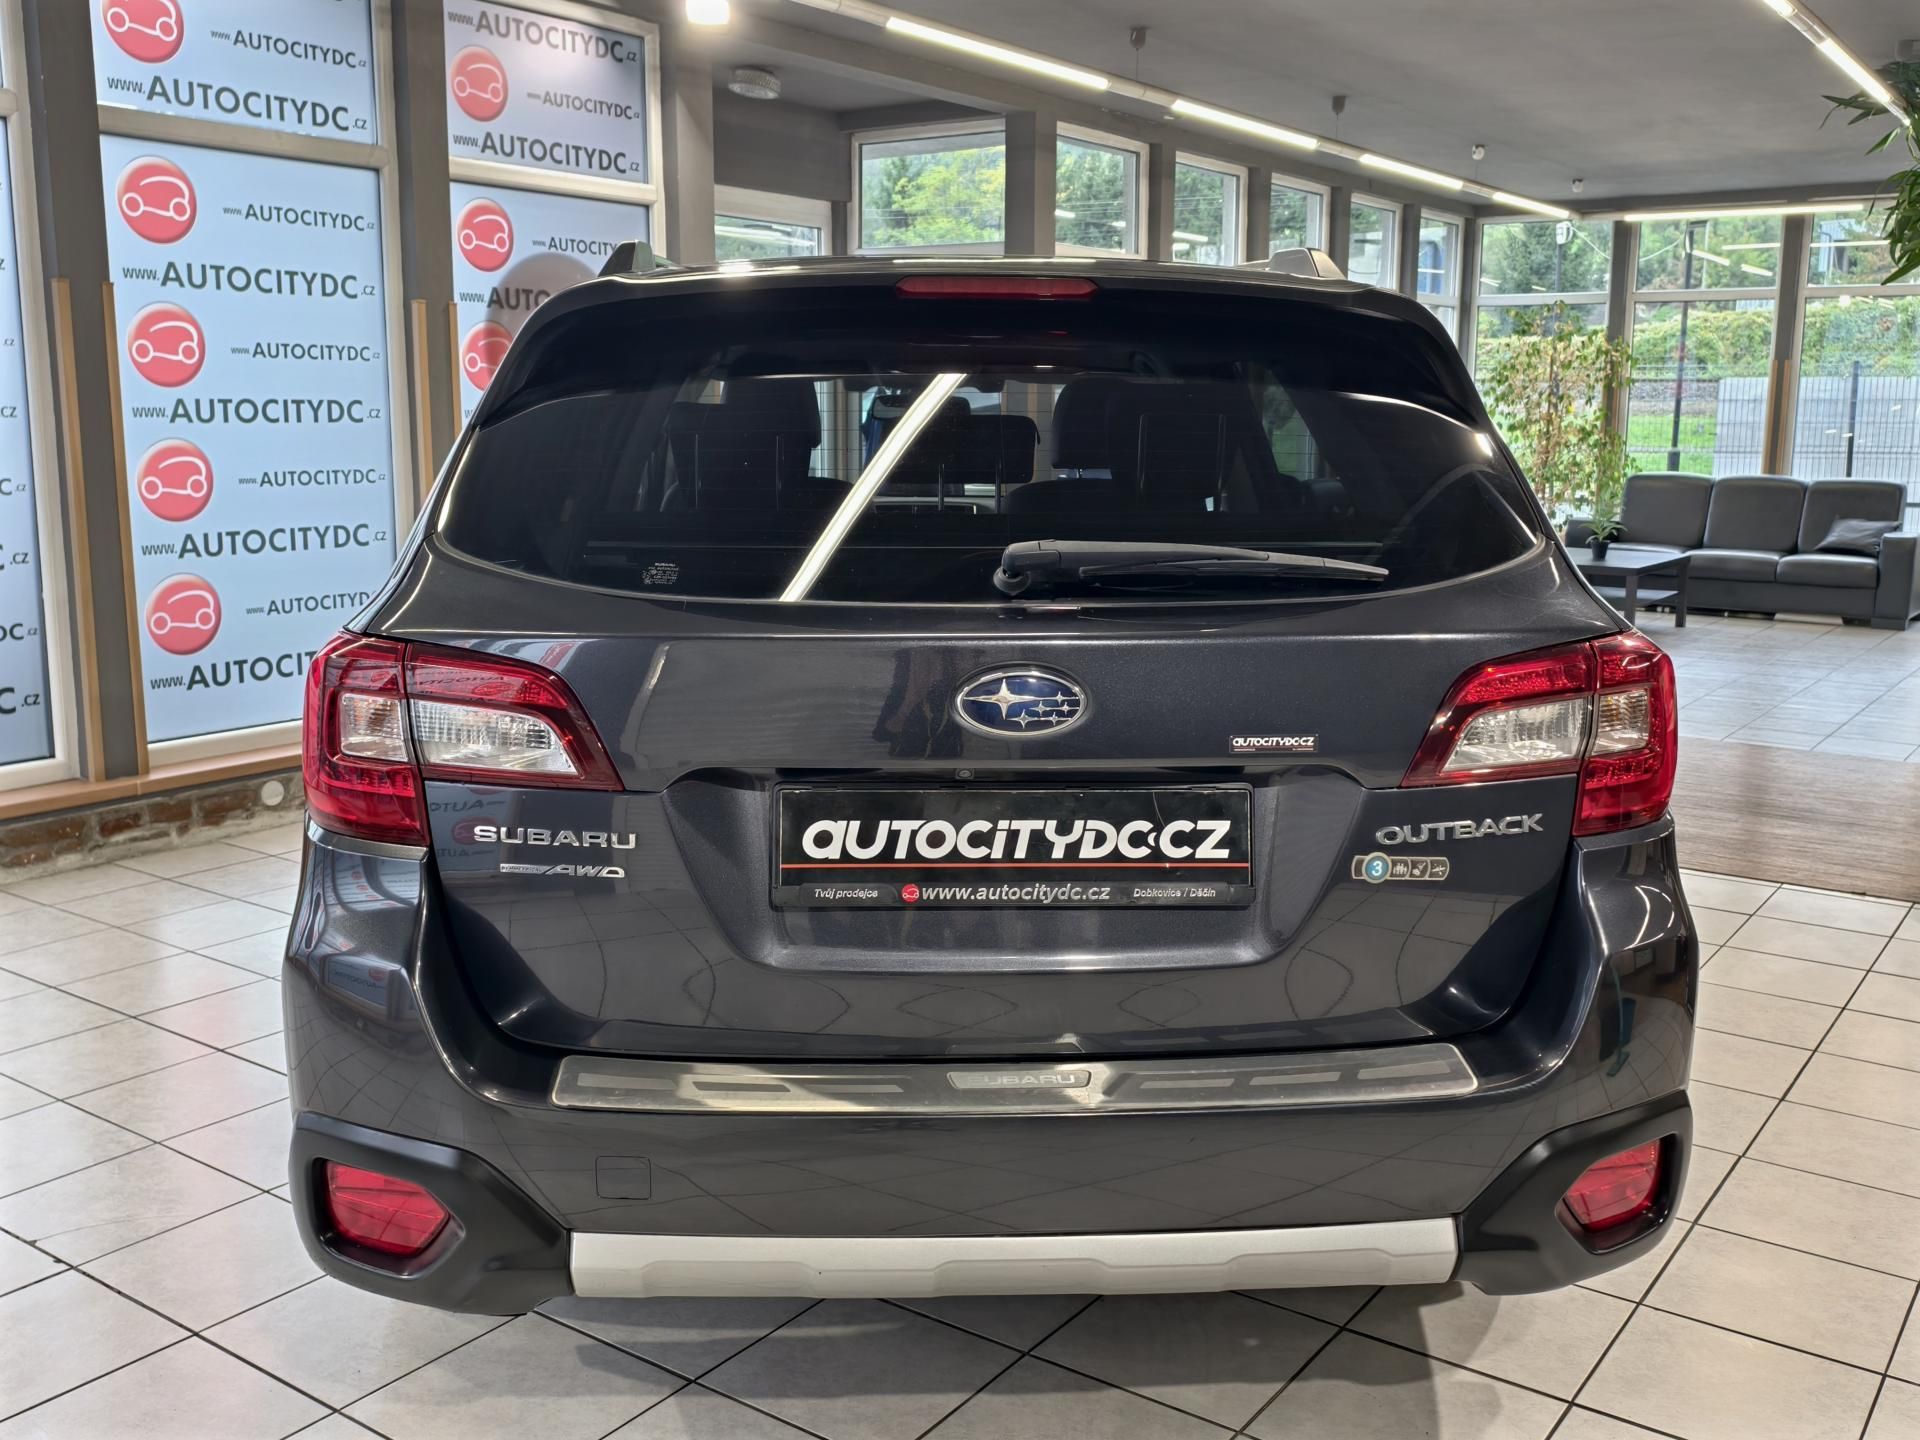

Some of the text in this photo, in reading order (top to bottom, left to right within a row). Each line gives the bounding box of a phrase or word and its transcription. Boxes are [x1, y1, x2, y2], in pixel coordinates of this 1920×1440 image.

[1375, 813, 1543, 845] OUTBACK
[474, 825, 637, 849] SUBARU
[545, 864, 625, 878] AWD
[1371, 861, 1383, 876] 3
[836, 889, 878, 899] prodejce
[922, 883, 1111, 904] www.autocitydc.cz
[1133, 887, 1181, 898] Dobkovice
[968, 1075, 1076, 1085] SUBARU
